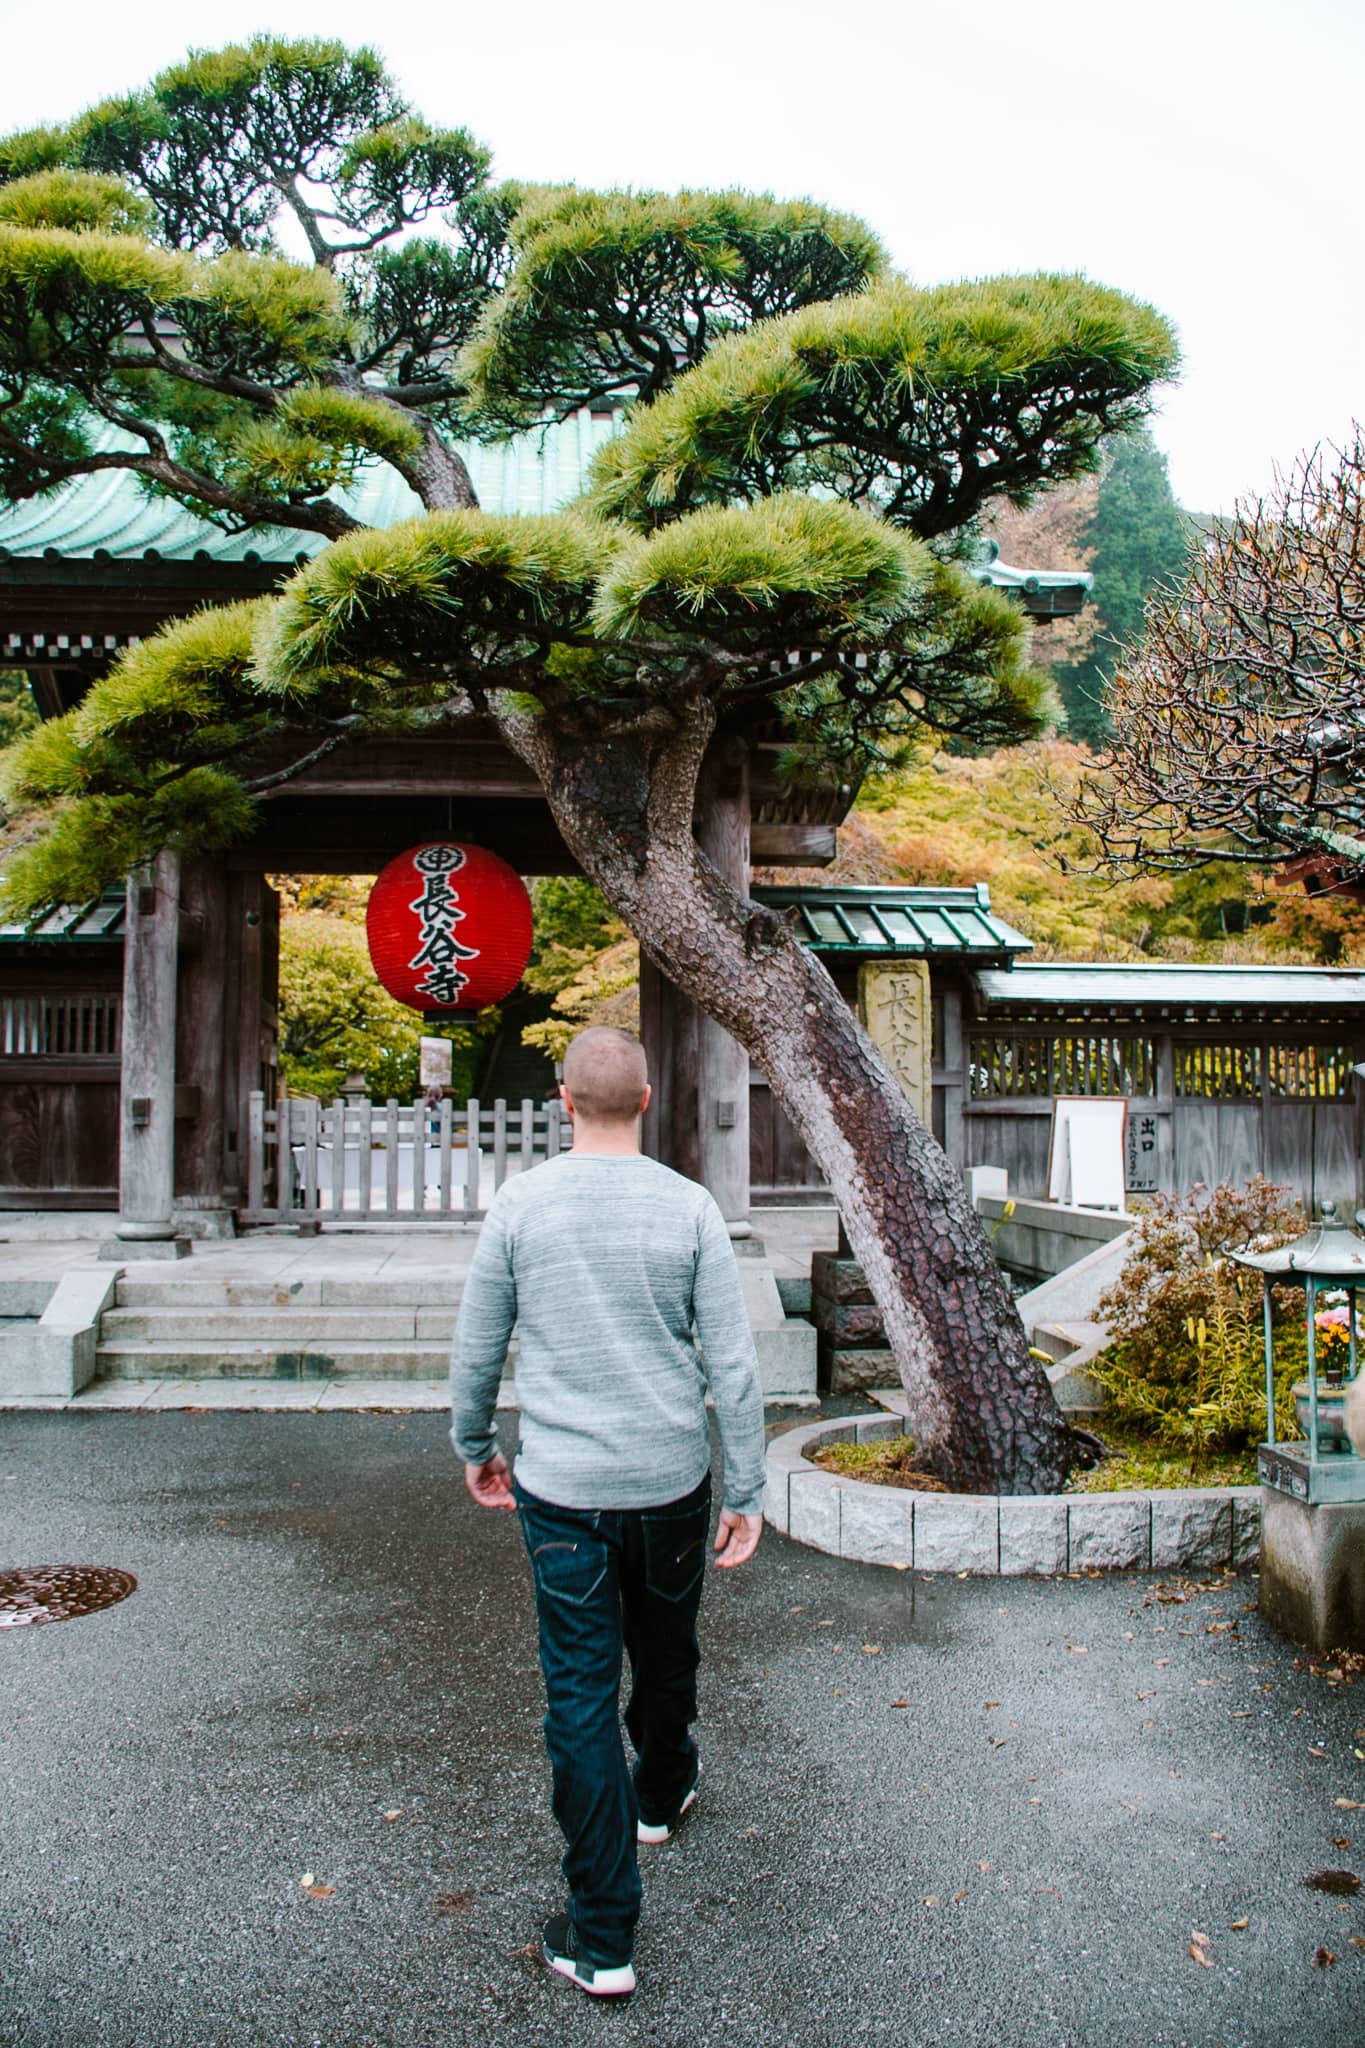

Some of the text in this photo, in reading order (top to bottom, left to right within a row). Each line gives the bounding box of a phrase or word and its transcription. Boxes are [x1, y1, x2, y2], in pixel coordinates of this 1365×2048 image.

[408, 874, 480, 1004] 長谷寺
[1141, 1118, 1155, 1152] 出口
[1129, 1180, 1154, 1188] EXIT
